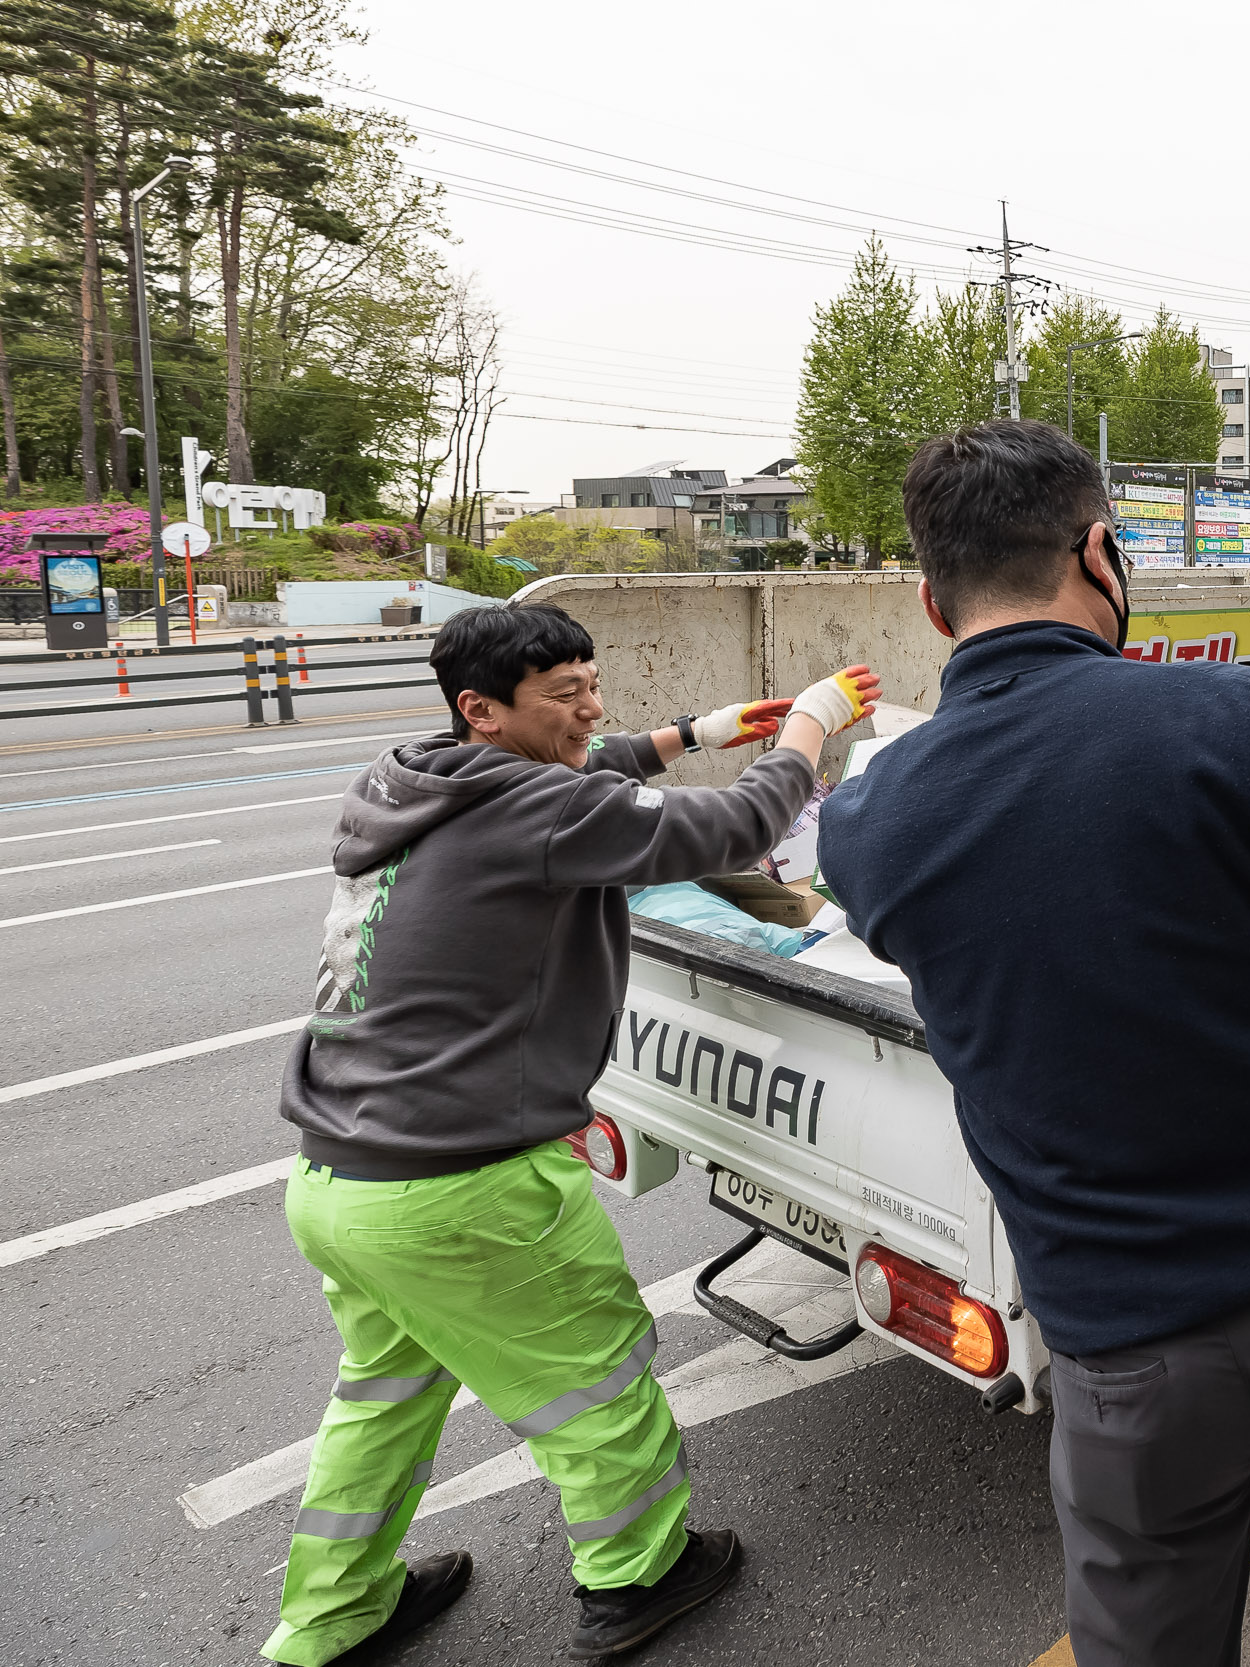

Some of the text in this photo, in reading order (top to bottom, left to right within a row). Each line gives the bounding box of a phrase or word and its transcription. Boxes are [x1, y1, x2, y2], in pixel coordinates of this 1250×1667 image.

[1197, 524, 1226, 535] 요양보호사
[66, 648, 160, 660] 무단횡단금지
[862, 1186, 956, 1241] 최대적재량 1000kg
